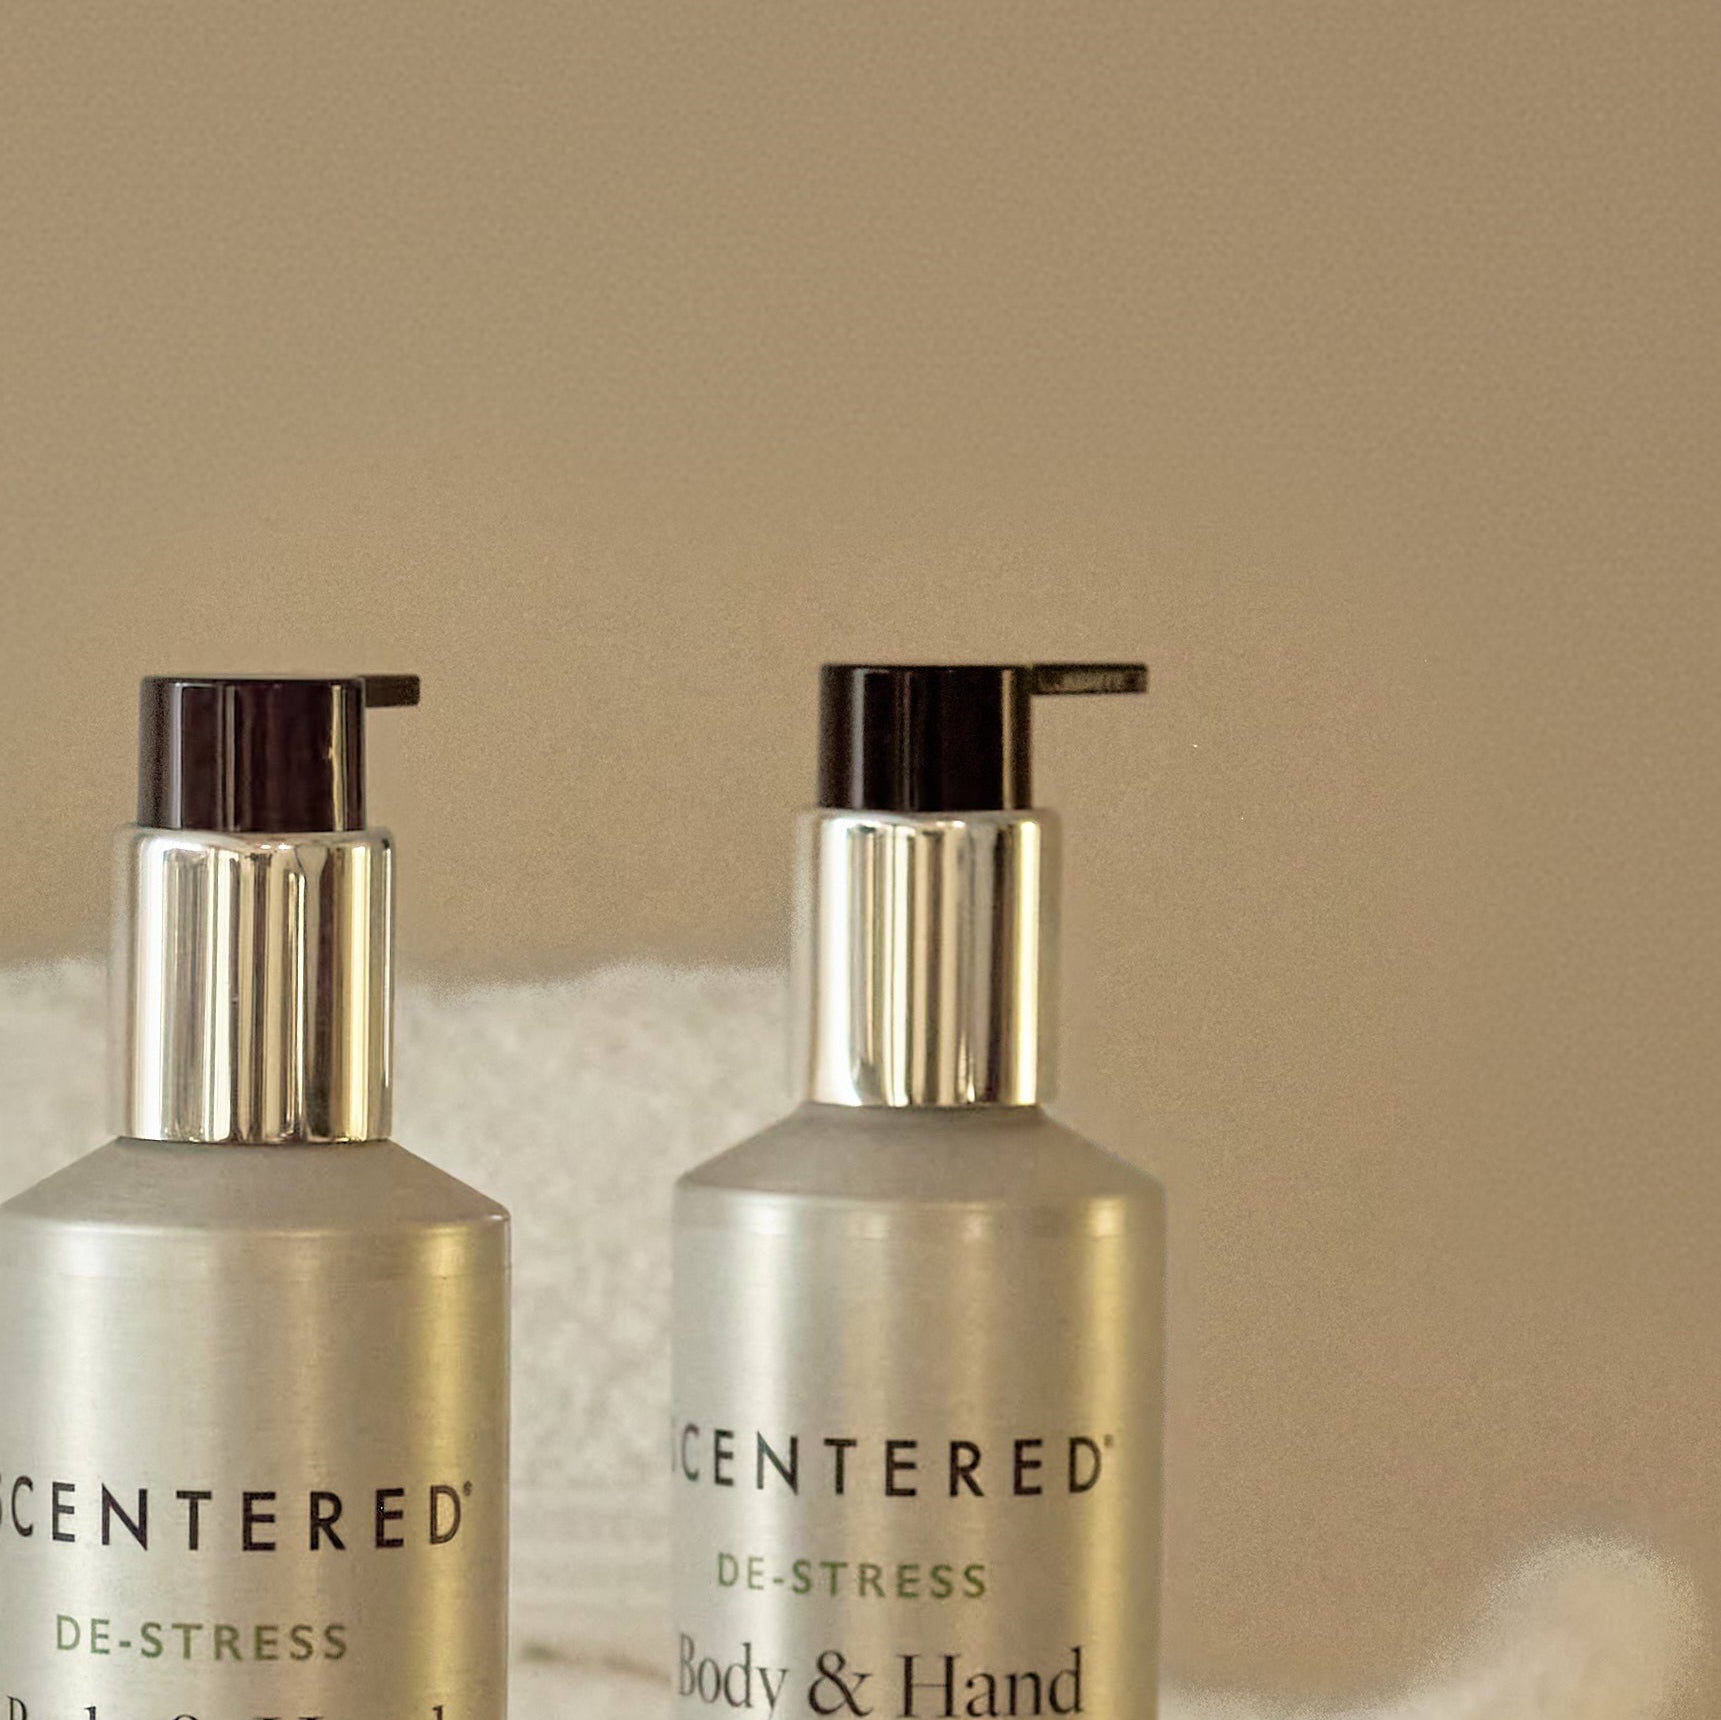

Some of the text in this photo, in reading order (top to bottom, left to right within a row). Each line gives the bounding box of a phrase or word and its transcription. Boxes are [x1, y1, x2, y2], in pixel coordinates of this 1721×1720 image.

[671, 1416, 1101, 1498] CENTERED
[717, 1552, 987, 1599] DE-STRESS
[56, 1614, 347, 1661] DE-STRESS
[807, 1650, 874, 1718] &
[896, 1646, 1086, 1719] Hand
